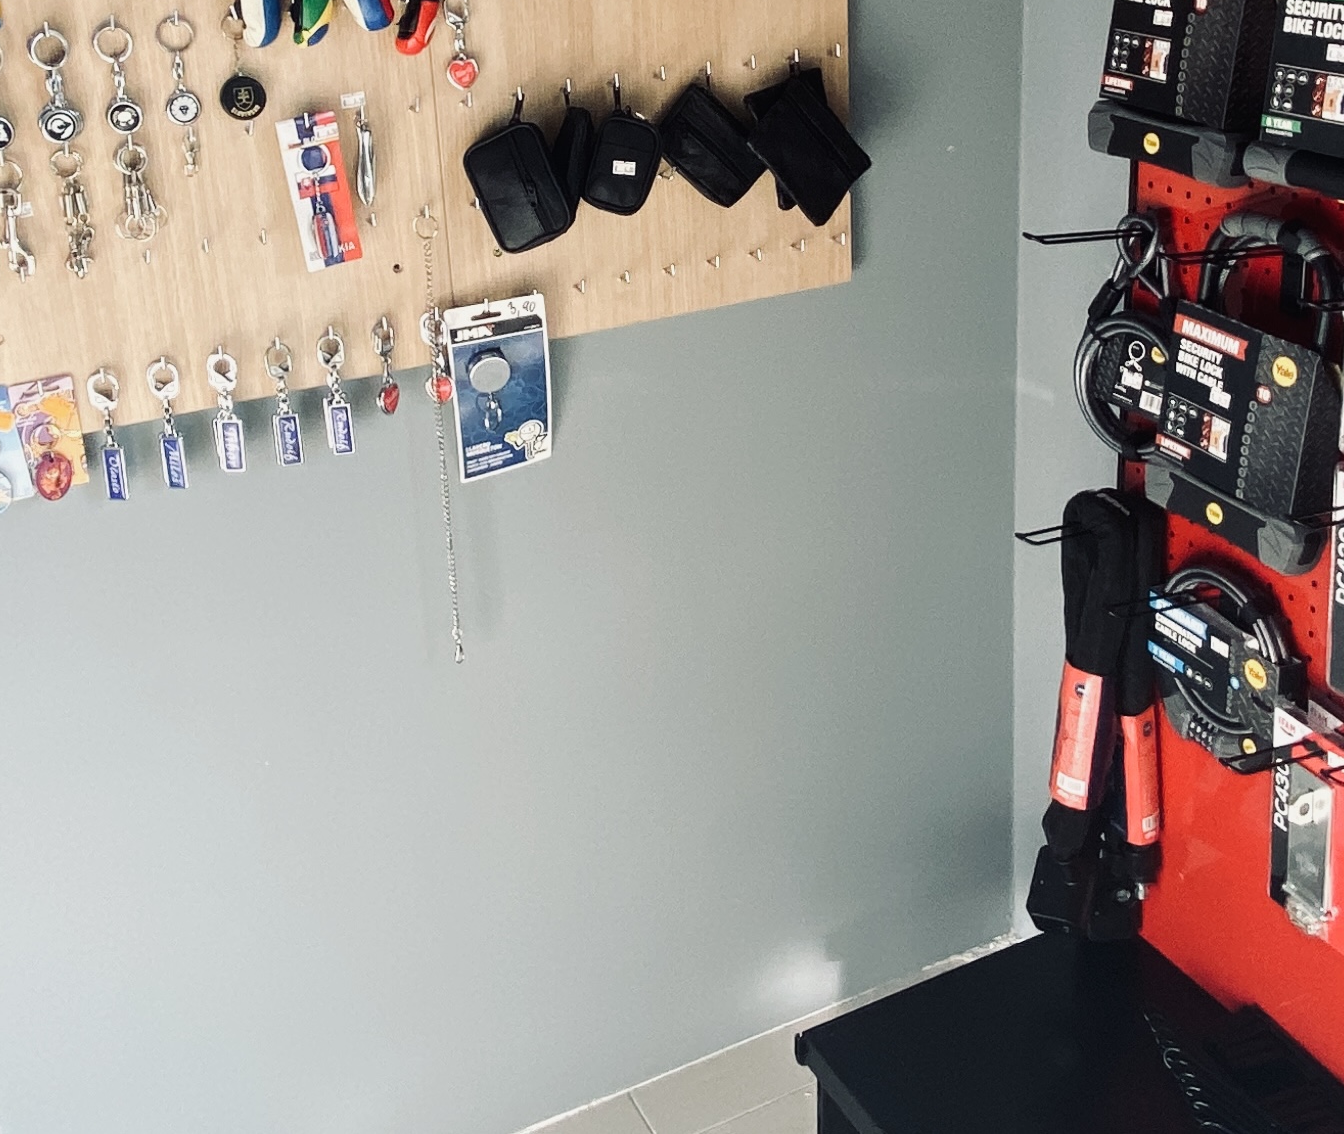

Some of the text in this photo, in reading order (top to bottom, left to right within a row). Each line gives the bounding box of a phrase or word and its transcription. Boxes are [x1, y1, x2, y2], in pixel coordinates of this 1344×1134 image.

[1283, 16, 1313, 35] BIKE
[1181, 319, 1241, 355] MAXIMUM
[1178, 350, 1223, 380] BIKE LOCK
[1179, 338, 1223, 366] SECURITY
[1175, 361, 1197, 381] WITH
